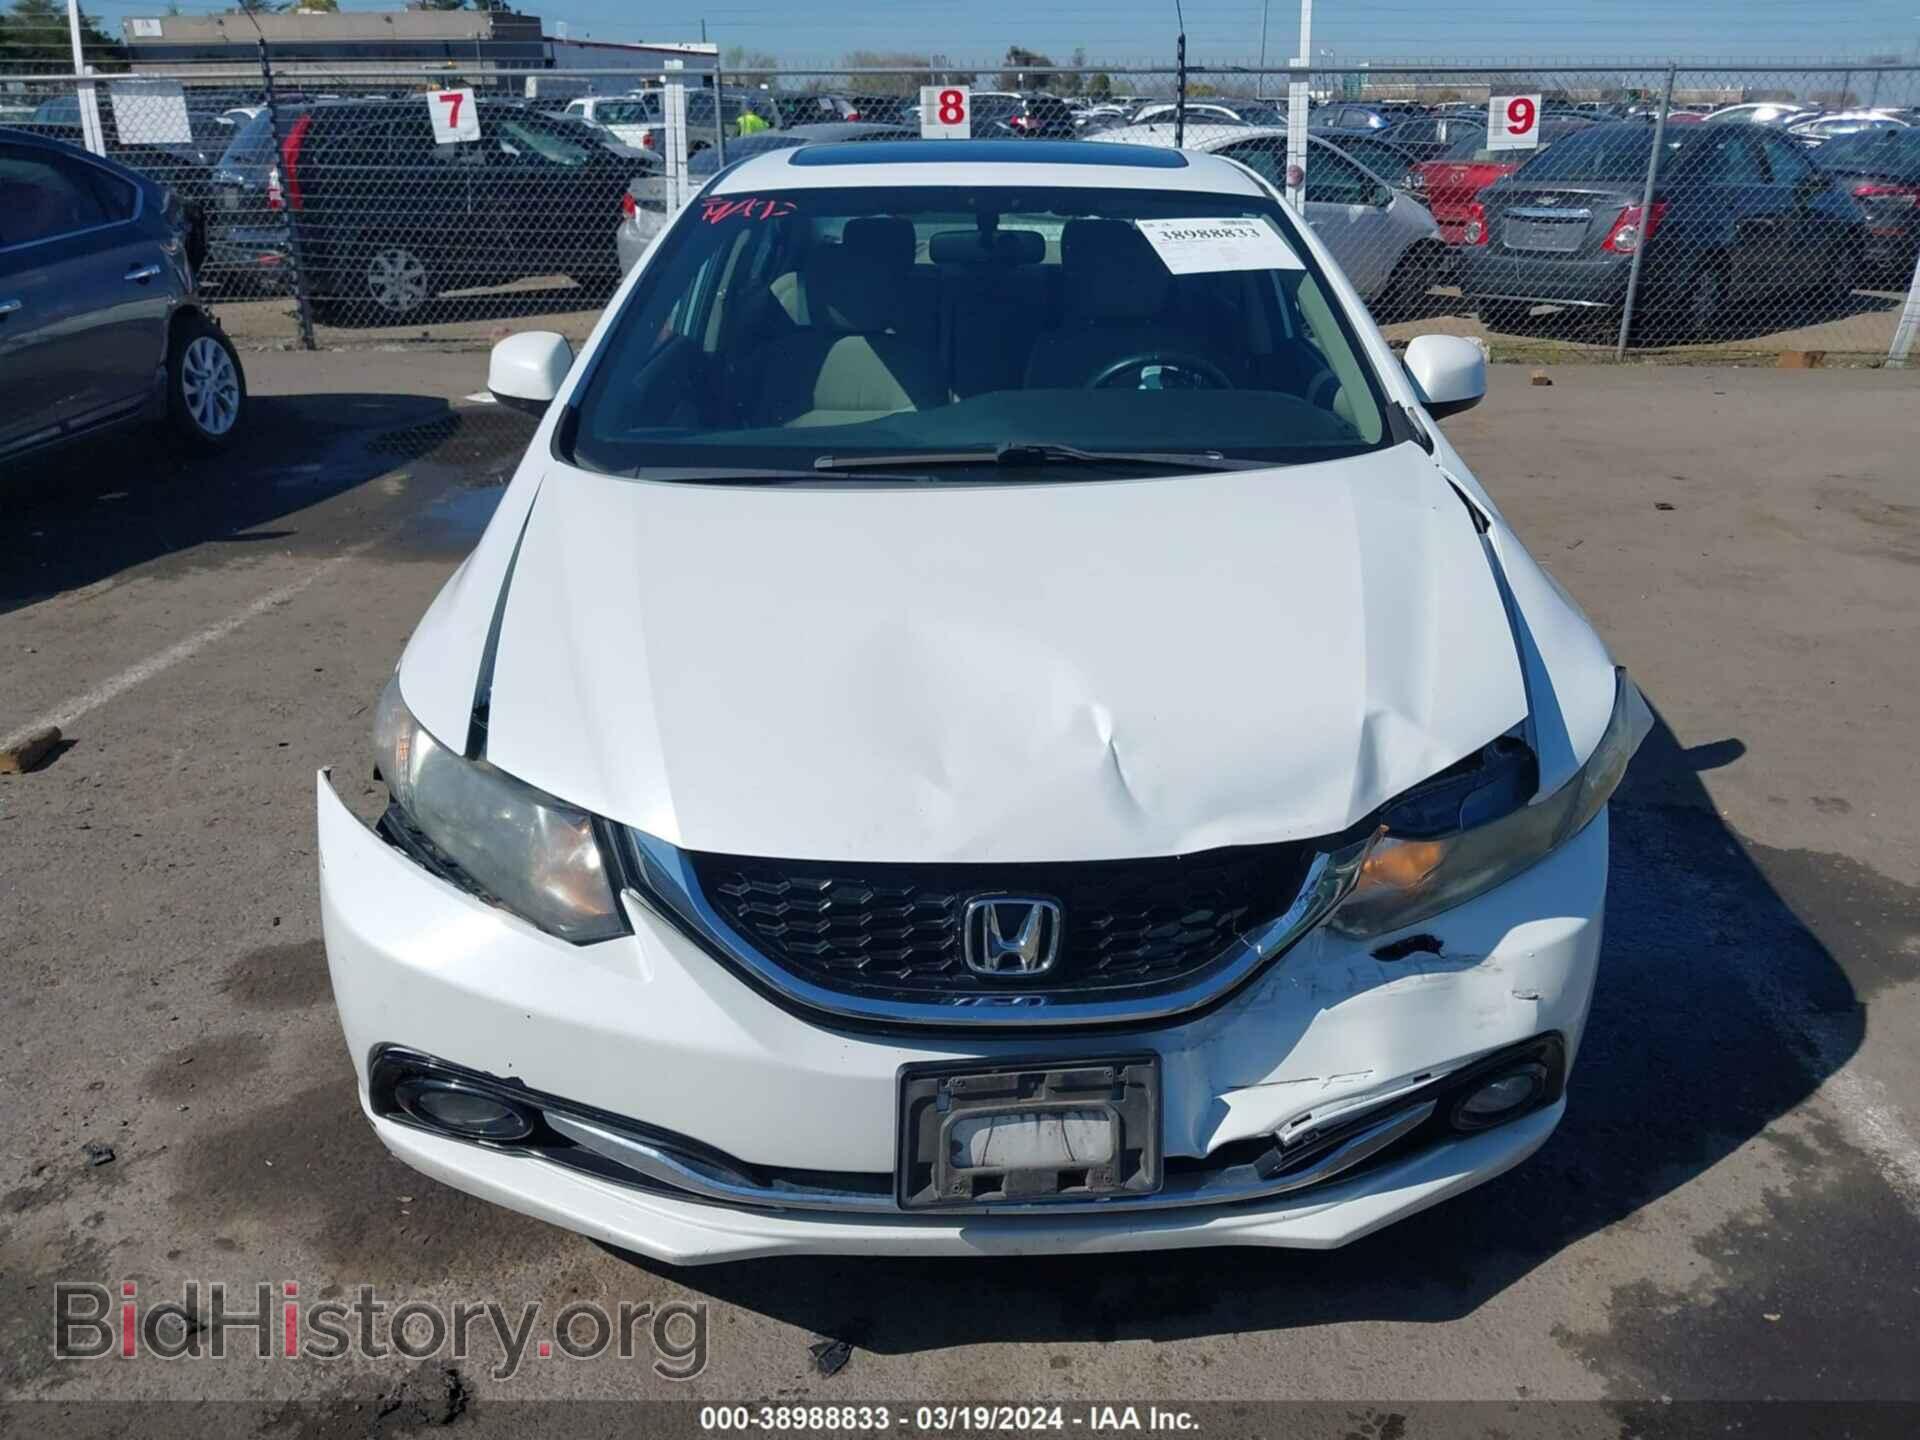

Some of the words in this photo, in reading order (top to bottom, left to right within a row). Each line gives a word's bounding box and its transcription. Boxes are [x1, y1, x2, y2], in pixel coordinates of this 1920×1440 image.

[438, 93, 464, 128] 7
[938, 89, 965, 125] 8
[1506, 97, 1536, 135] 9
[1158, 228, 1262, 240] 38988833
